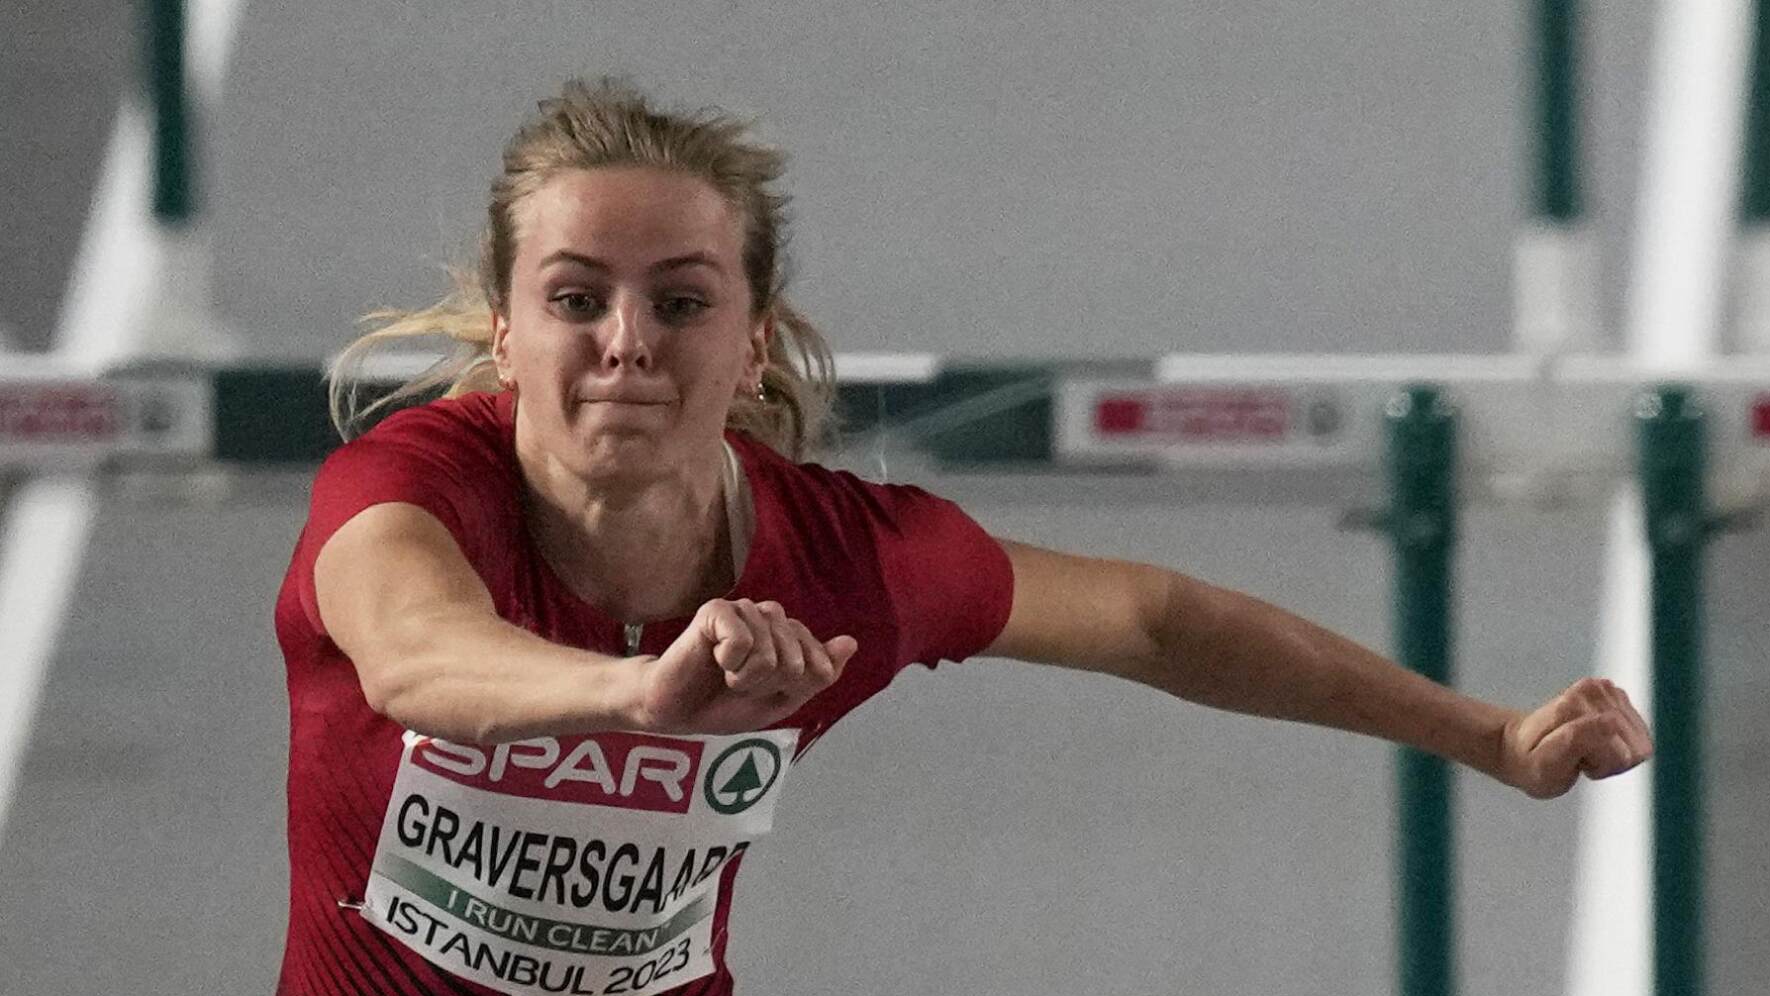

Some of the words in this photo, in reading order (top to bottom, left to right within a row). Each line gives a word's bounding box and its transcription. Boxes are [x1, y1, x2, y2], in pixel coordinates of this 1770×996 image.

[420, 736, 691, 803] SPAR
[387, 896, 594, 995] ISTANBUL
[603, 937, 691, 995] 2023
[447, 890, 457, 909] I
[465, 898, 540, 941] RUN
[547, 924, 658, 953] CLEAN
